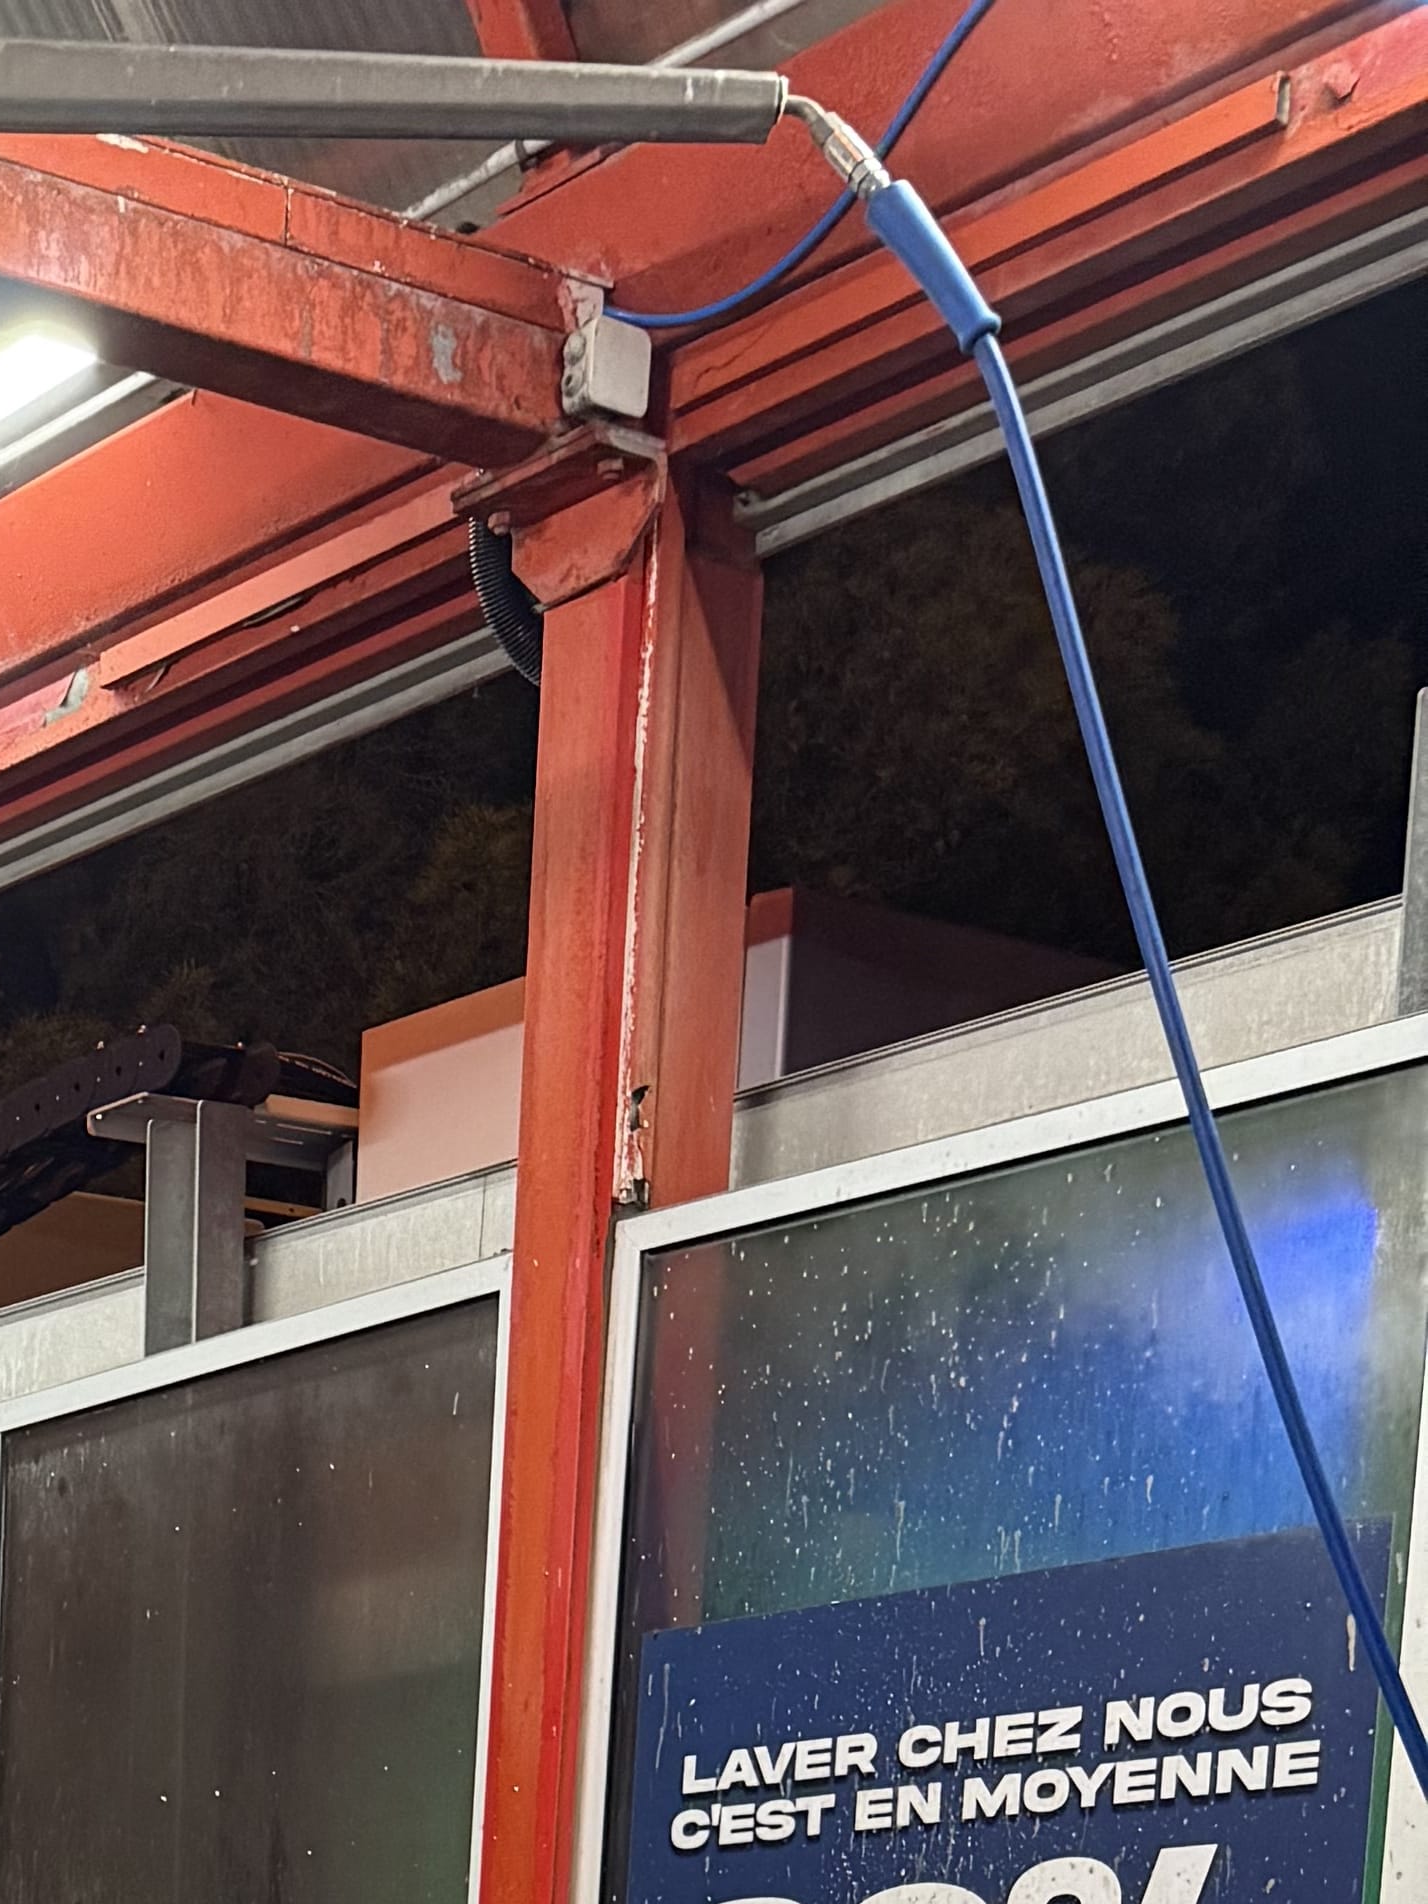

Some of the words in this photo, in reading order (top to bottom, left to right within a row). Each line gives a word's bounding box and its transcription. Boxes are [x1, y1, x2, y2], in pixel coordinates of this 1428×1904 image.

[670, 1794, 836, 1850] C'EST
[853, 1781, 943, 1831] EN
[961, 1738, 1322, 1821] MOYENNE
[681, 1732, 879, 1796] LAVER
[898, 1704, 1084, 1768] CHEZ
[1104, 1677, 1314, 1746] NOUS
